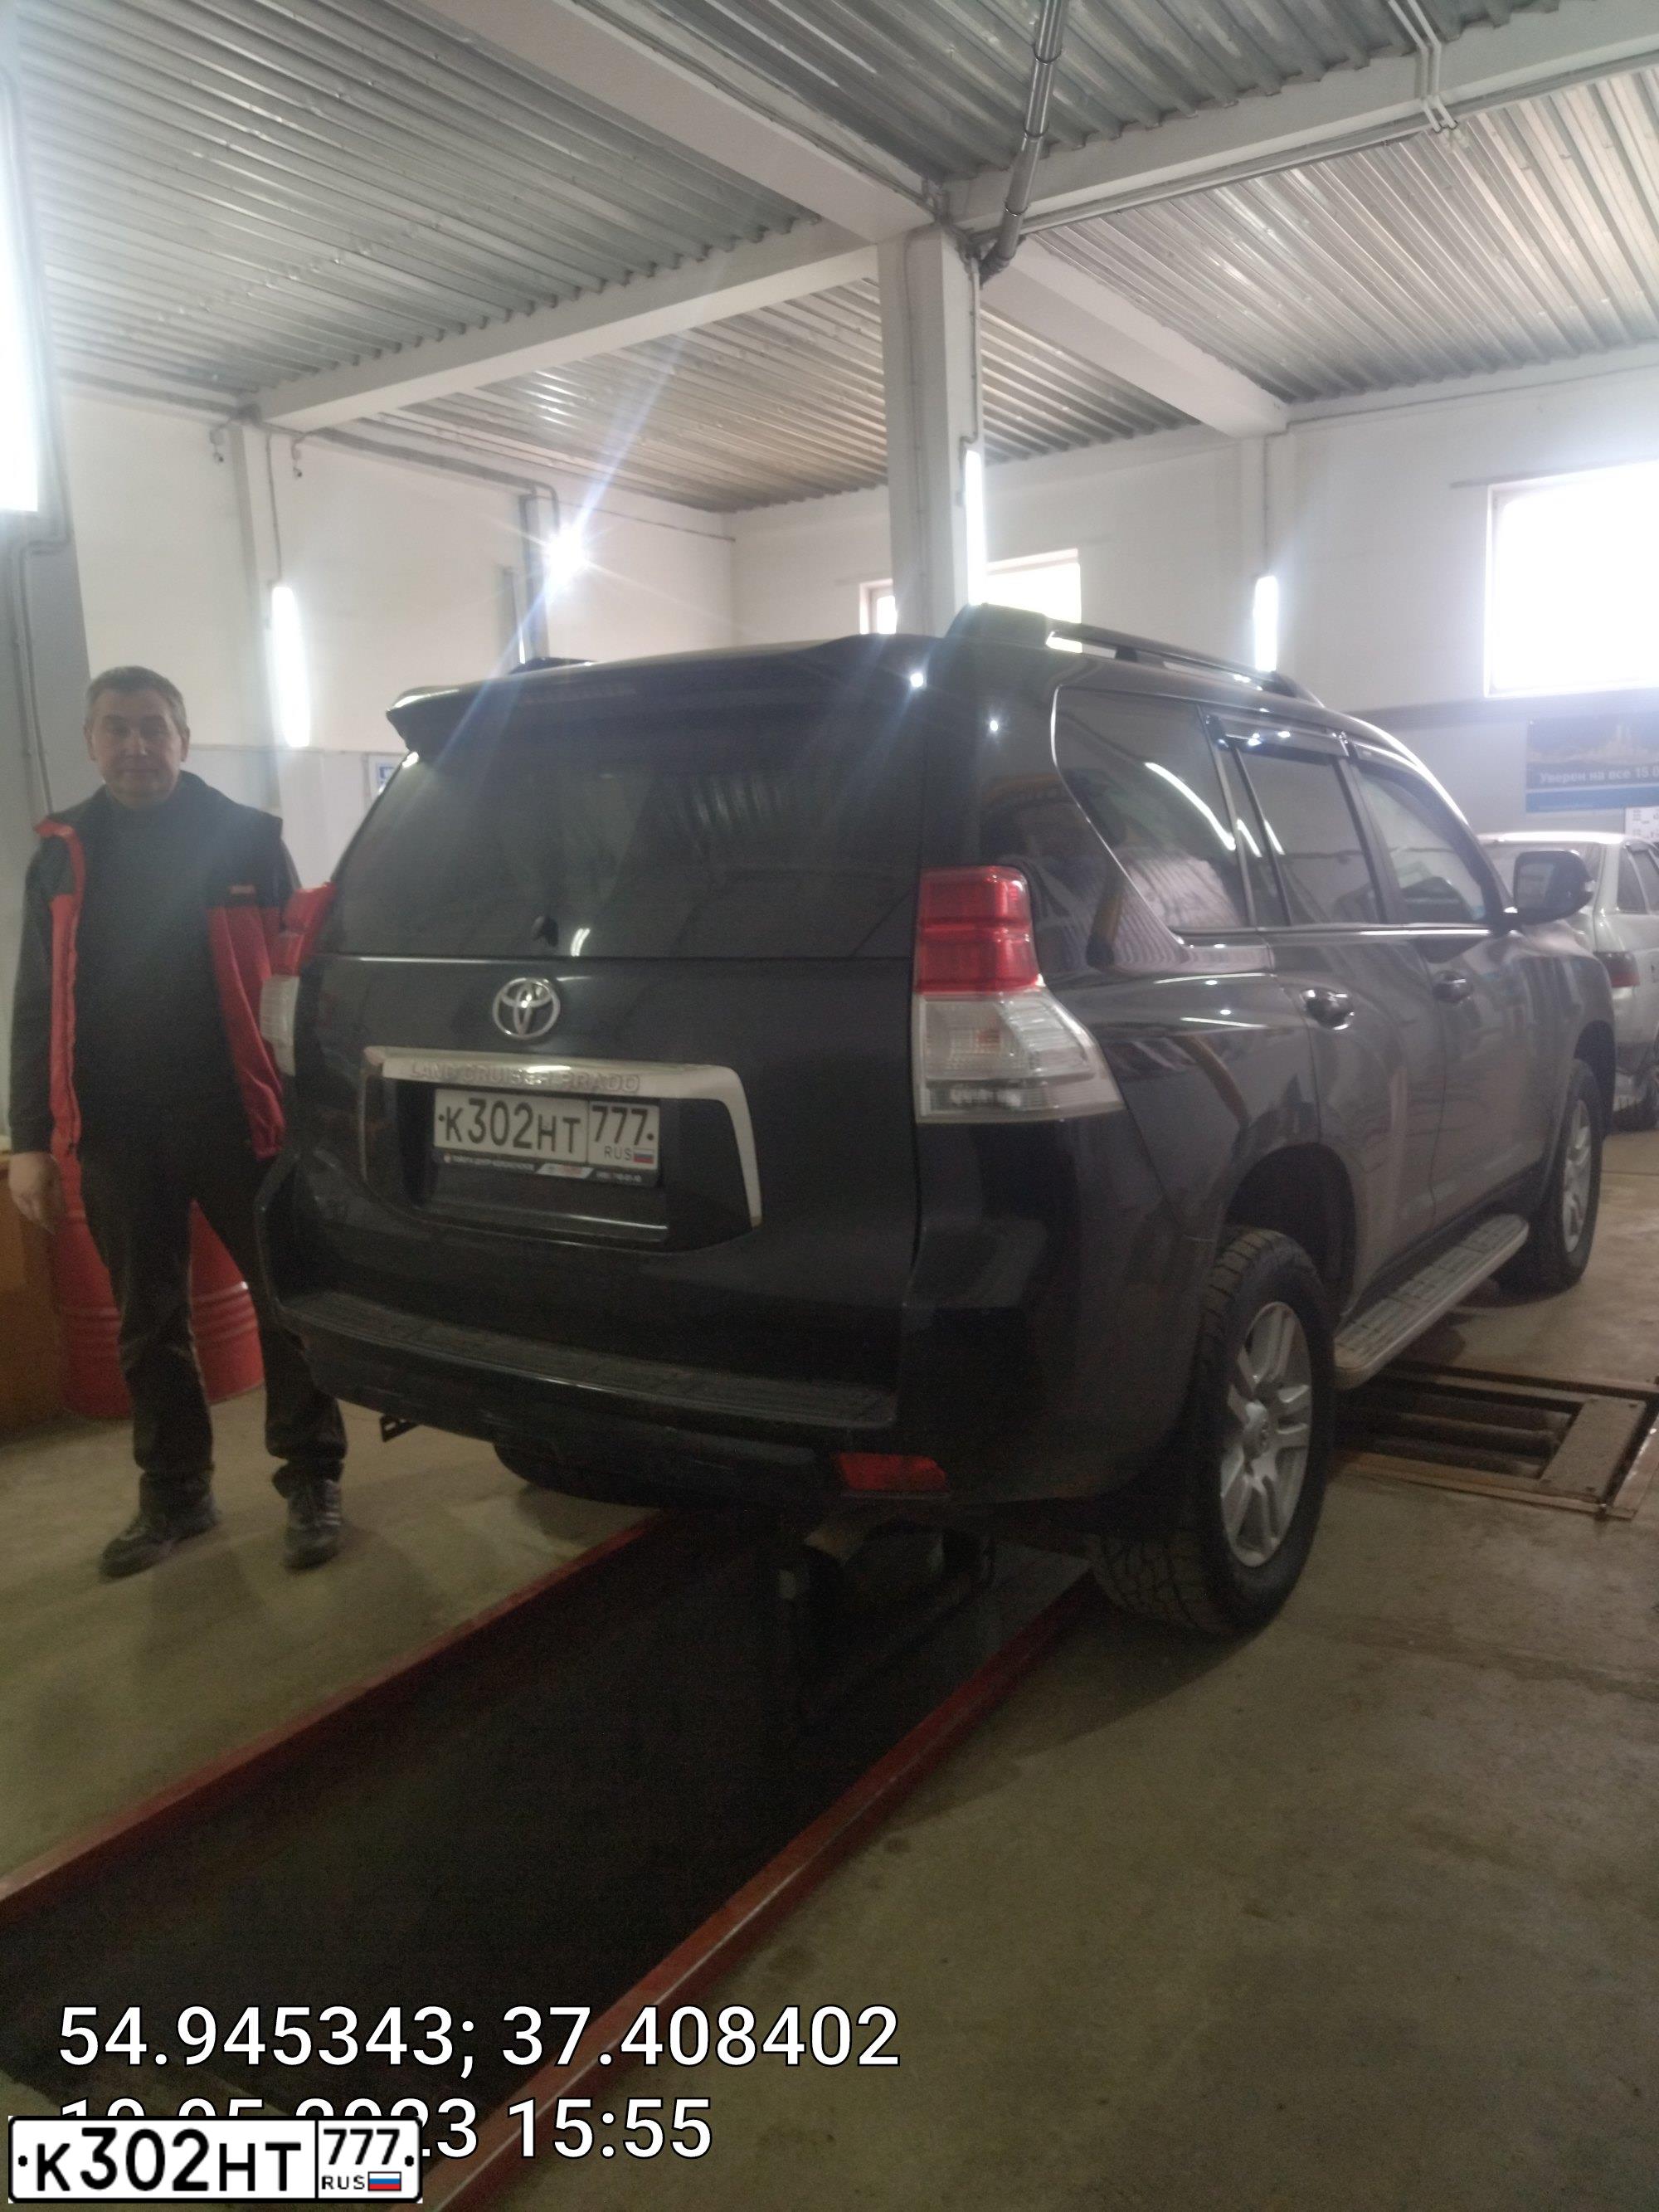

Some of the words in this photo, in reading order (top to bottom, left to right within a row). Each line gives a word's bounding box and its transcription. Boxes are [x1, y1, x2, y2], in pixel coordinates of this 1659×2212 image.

[445, 1097, 581, 1154] К302НТ
[591, 1104, 649, 1146] 777
[604, 1145, 632, 1161] RUS
